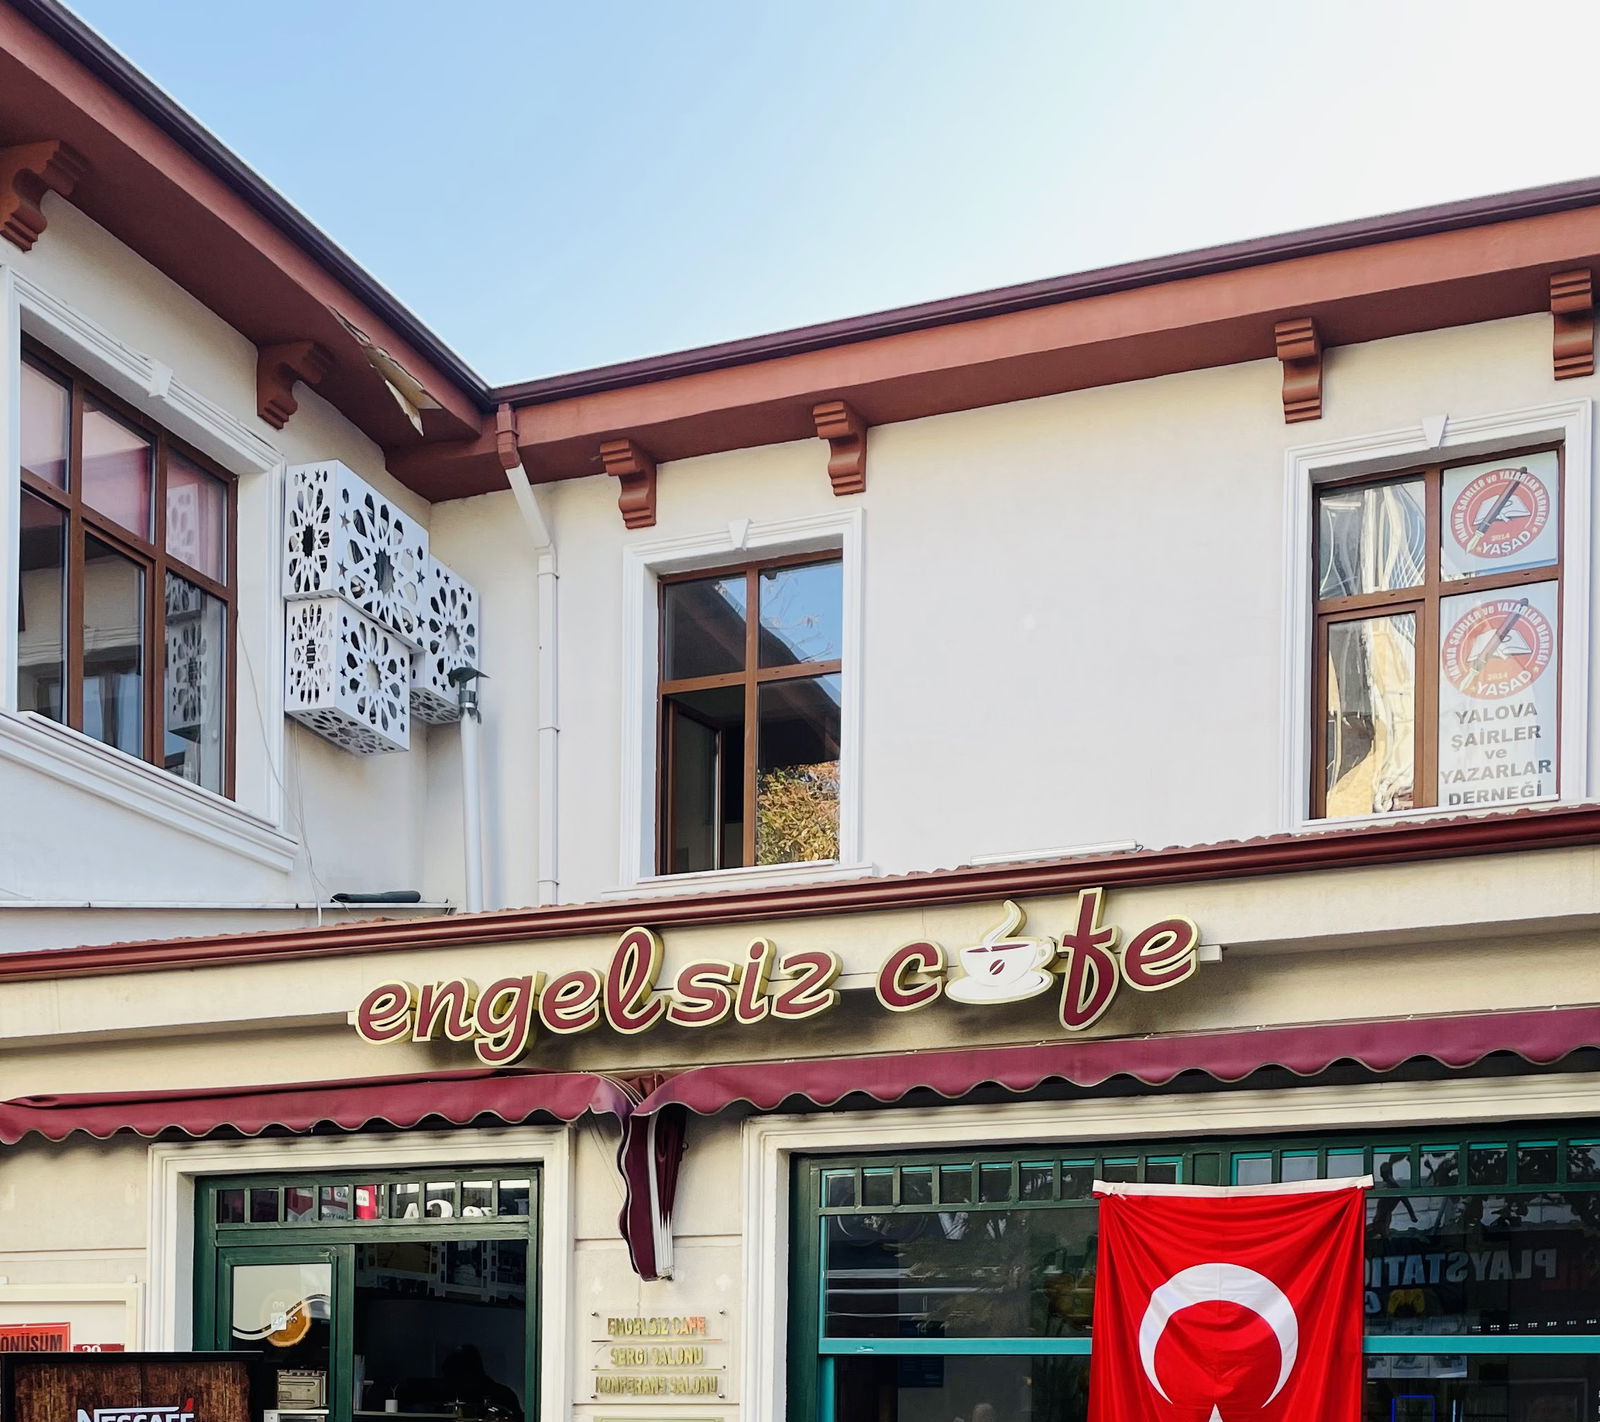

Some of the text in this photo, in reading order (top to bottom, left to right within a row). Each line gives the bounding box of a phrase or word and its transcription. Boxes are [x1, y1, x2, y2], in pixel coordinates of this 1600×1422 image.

[1455, 702, 1538, 725] YALOVA
[1451, 724, 1542, 752] ŞAİRLER
[1484, 748, 1508, 760] ve
[1440, 759, 1552, 785] YAZARLAR
[1448, 780, 1542, 806] DERNEĞİ
[355, 926, 843, 1065] engelsiz
[672, 1316, 706, 1335] CAFE
[651, 1347, 703, 1365] SALONU
[596, 1376, 718, 1395] KONFERANS SALONU
